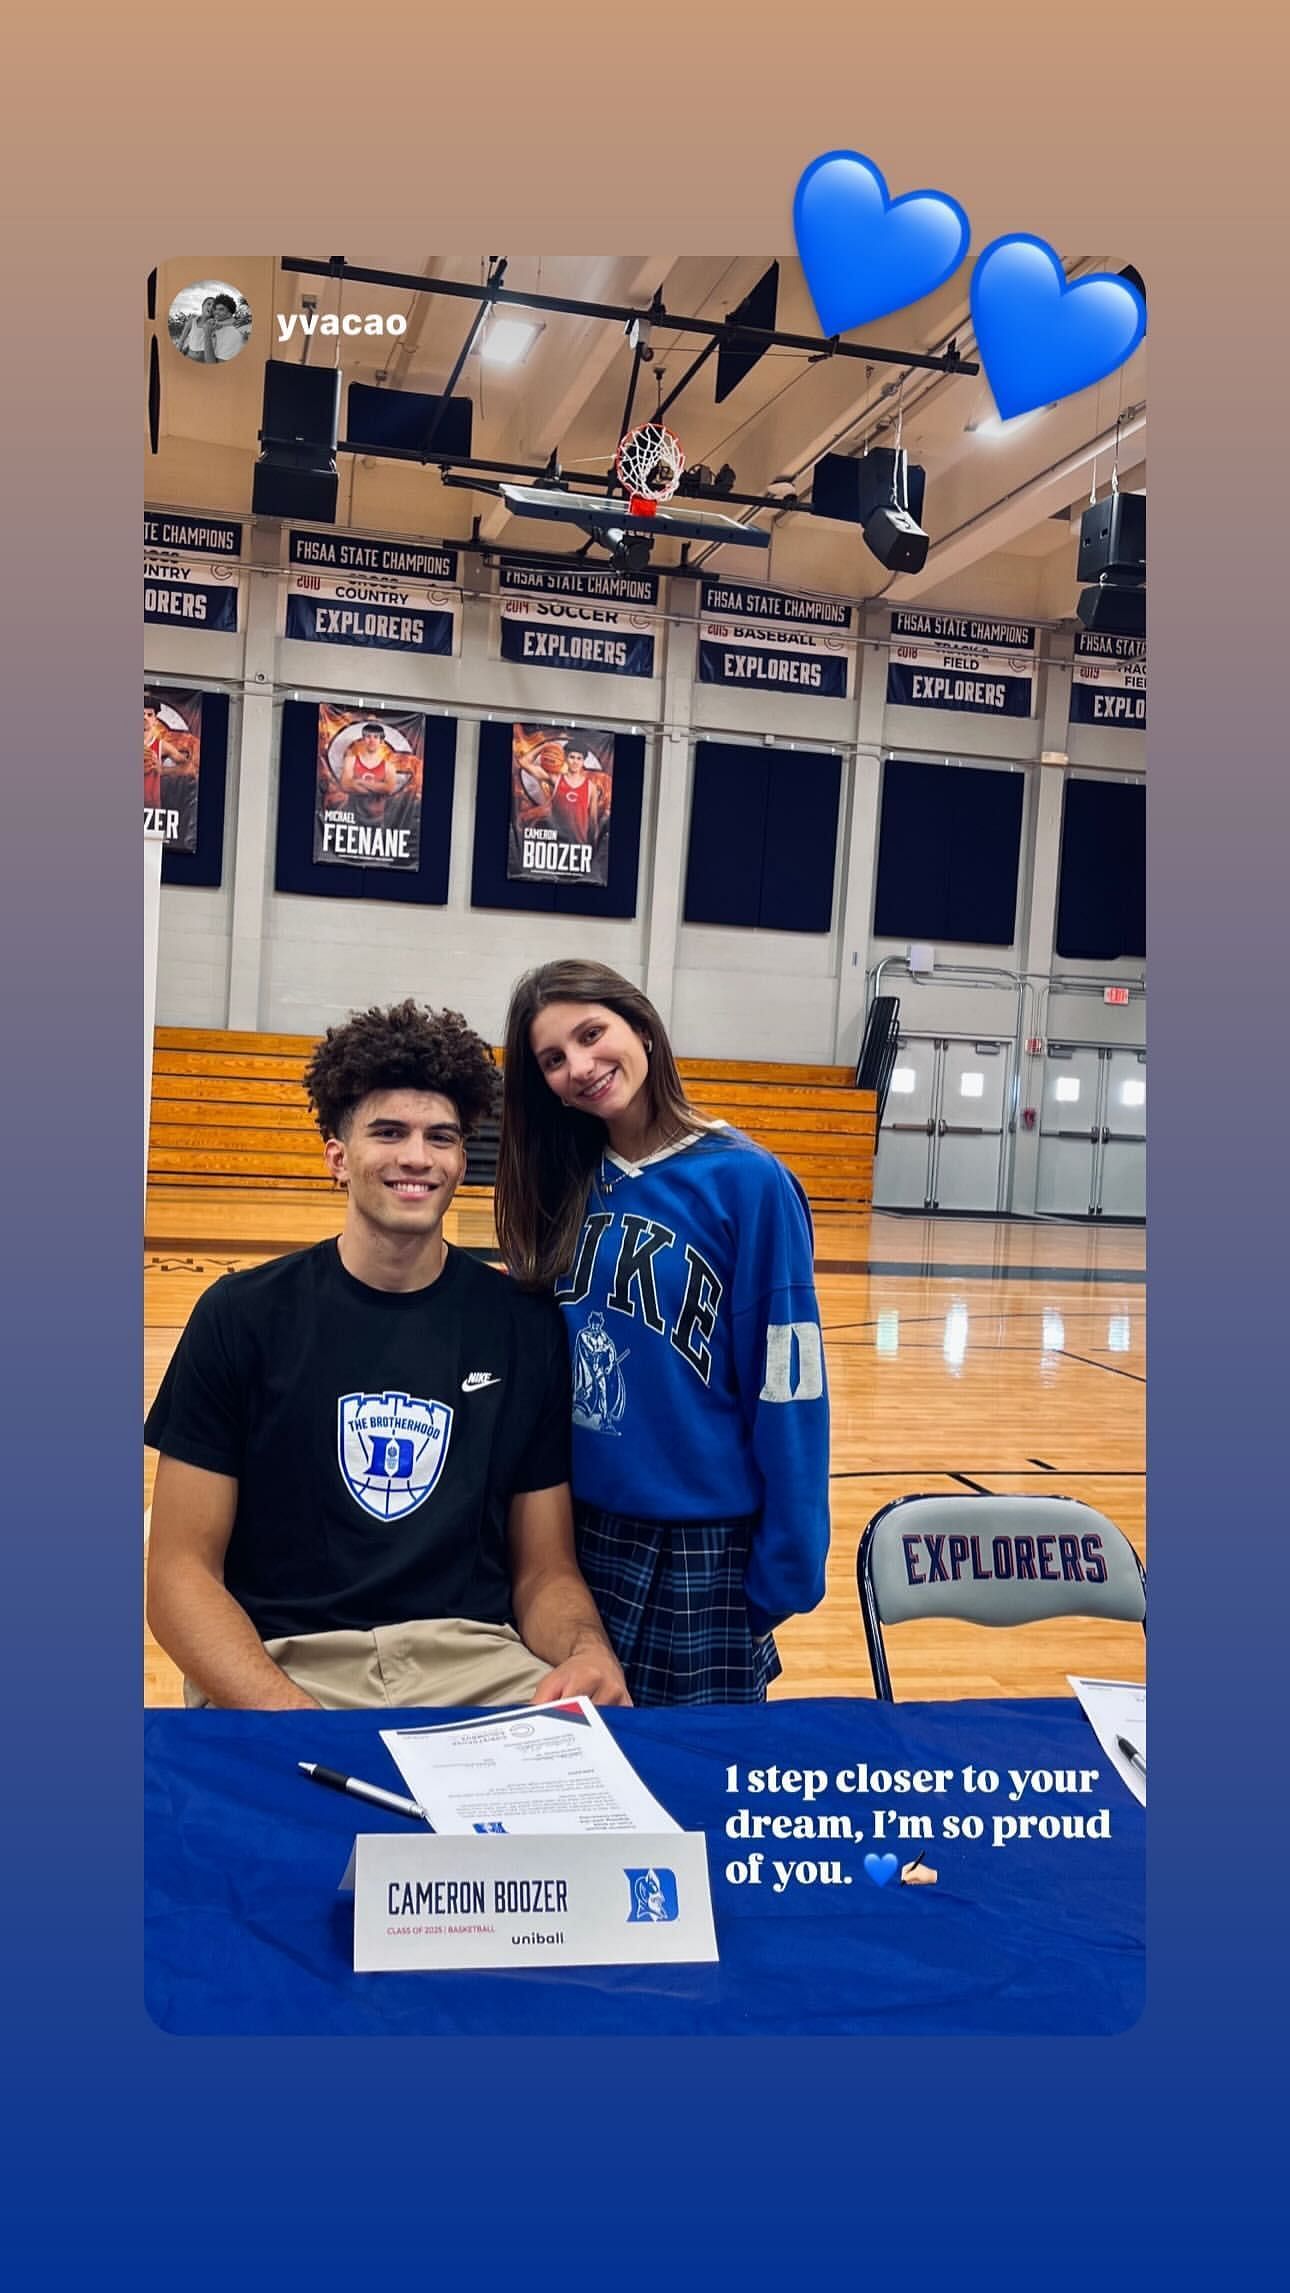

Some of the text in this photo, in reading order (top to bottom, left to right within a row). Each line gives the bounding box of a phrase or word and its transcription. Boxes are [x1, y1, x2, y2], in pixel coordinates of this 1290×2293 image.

[162, 524, 235, 550] CHAMPIONS
[296, 540, 450, 576] FHSAA STATE CHAMPIONS
[335, 586, 409, 606] COUNTRY
[587, 577, 652, 600] CHAMPIONS
[536, 602, 619, 625] SOCCER
[707, 589, 846, 623] FHSAA STATE CHAMPIONS
[315, 607, 425, 644] EXPLORERS
[733, 626, 817, 647] BASEBALL
[897, 613, 1029, 645] FHSAA STATE CHAMPIONS
[523, 631, 627, 667] EXPLORERS
[1080, 633, 1113, 654] FHSAA
[724, 653, 822, 688] EXPLORERS
[943, 656, 980, 671] FIELD
[912, 674, 1006, 708] EXPLORERS
[1093, 695, 1146, 719] EXPLO
[324, 809, 356, 824] MICHAEL
[322, 823, 411, 858] FEENANE
[524, 827, 558, 841] CAMERON
[522, 840, 593, 873] BOOZER
[554, 1212, 723, 1386] UKE
[468, 1371, 493, 1384] NIKE
[347, 1415, 441, 1440] THE BROTHERHOOD
[900, 1532, 1109, 1586] EXPLORERS
[387, 1879, 569, 1916] CAMERON BOOZER
[386, 1926, 411, 1936] CLASS
[412, 1926, 422, 1935] OF
[447, 1924, 496, 1934] BASKETBALL
[511, 1932, 565, 1946] uniball
